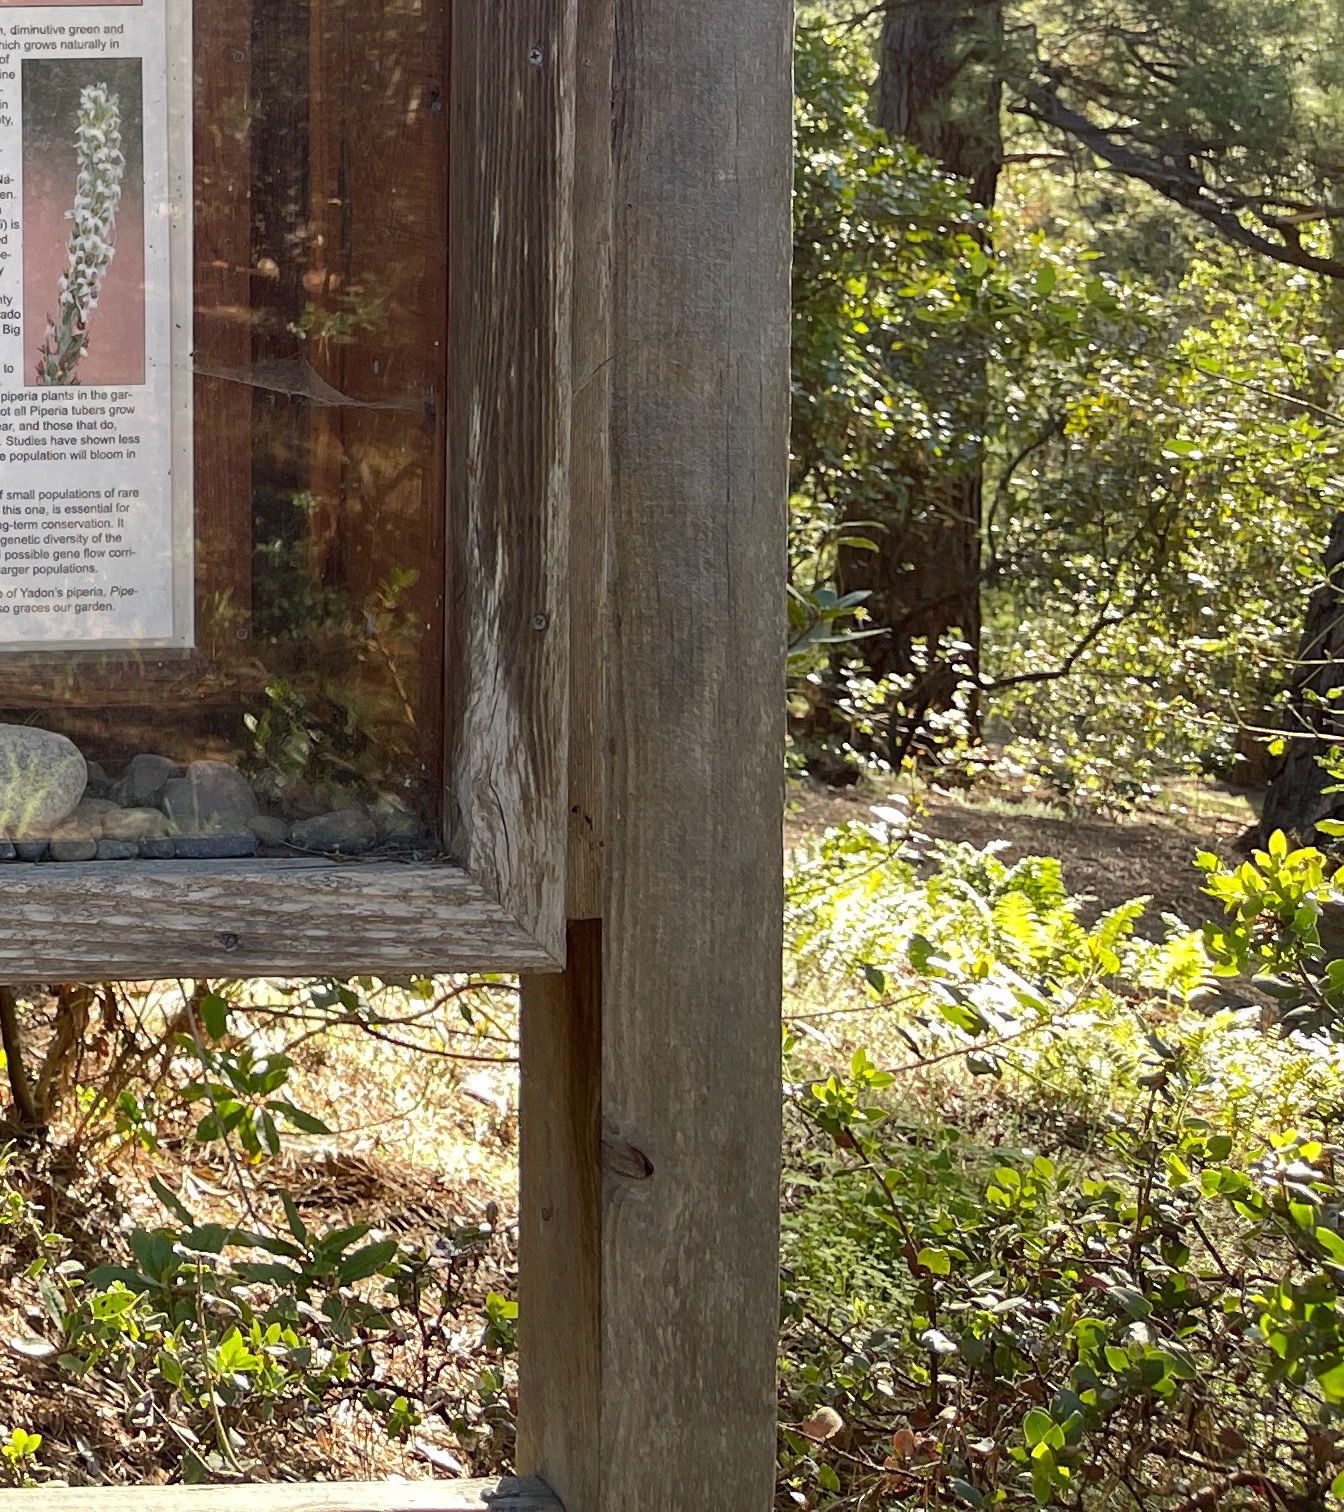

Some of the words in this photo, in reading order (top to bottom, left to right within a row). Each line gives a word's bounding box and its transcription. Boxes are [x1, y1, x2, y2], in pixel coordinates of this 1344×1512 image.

[10, 25, 65, 34] diminutive
[69, 26, 100, 36] green
[104, 24, 124, 34] and
[24, 41, 57, 52] grows
[60, 39, 107, 51] naturally
[110, 40, 119, 49] in
[0, 55, 9, 64] of
[0, 101, 8, 109] in
[6, 435, 47, 446] Studies
[50, 436, 77, 445] have
[80, 435, 115, 444] shown
[119, 435, 140, 444] less
